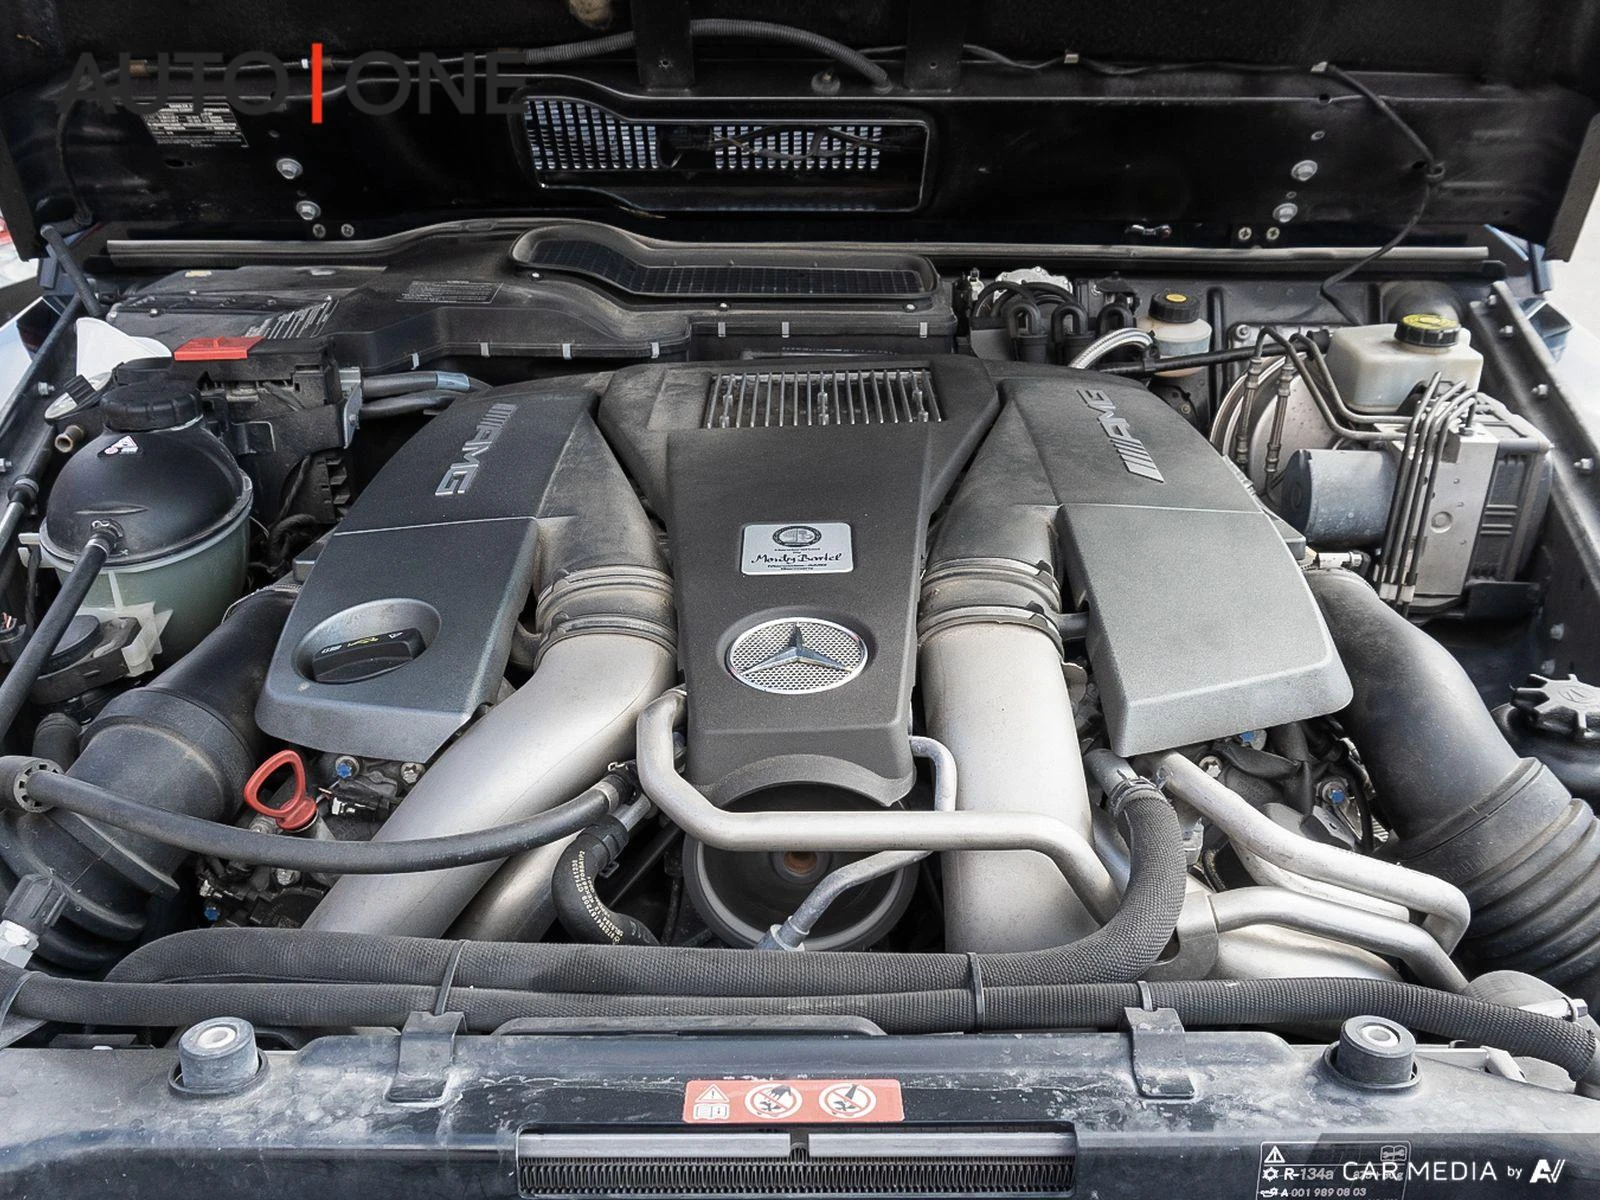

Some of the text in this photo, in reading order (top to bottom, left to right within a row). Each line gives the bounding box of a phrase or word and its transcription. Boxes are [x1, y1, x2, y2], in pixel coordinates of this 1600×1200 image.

[1283, 1167, 1334, 1181] R-134a
[1291, 1187, 1310, 1197] 001
[1313, 1187, 1335, 1197] 989
[1336, 1187, 1351, 1197] 08
[1352, 1187, 1367, 1197] 03
